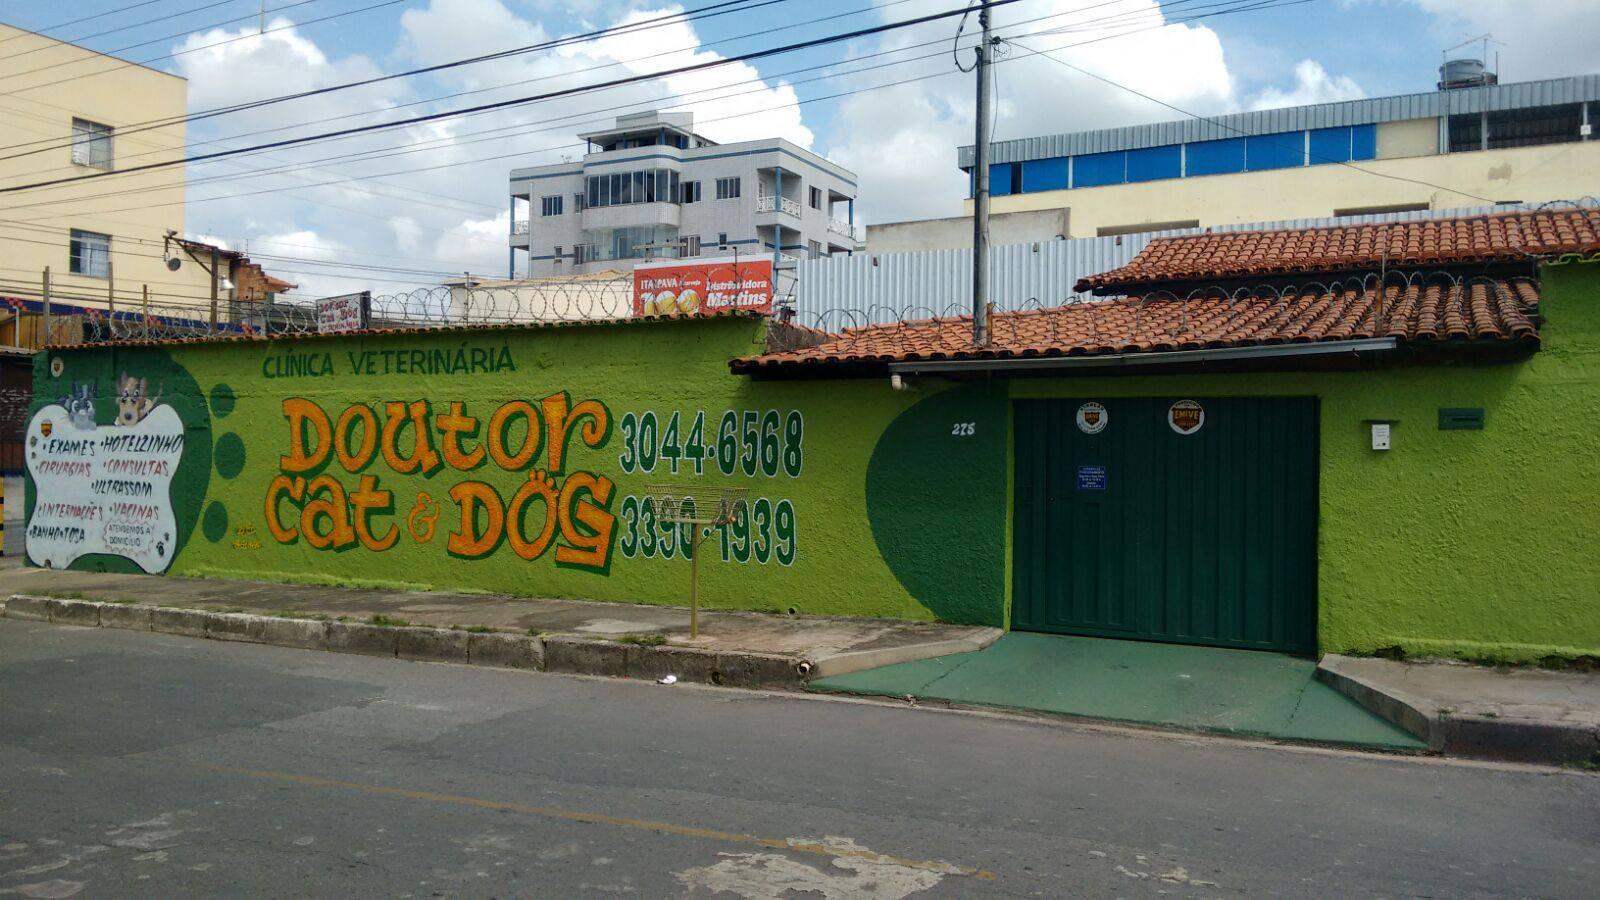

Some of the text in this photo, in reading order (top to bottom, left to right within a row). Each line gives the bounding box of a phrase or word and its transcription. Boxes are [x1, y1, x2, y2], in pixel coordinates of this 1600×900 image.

[263, 341, 516, 379] CLÍNICA VETERINÁRIA
[1174, 409, 1199, 419] EMIVE
[952, 422, 975, 436] 275
[49, 439, 95, 456] EXAMES
[103, 434, 184, 453] HOTELZINHO
[39, 461, 91, 477] CIRURGIAS
[107, 459, 168, 477] CONSULTAS
[94, 480, 152, 498] ULTRASSOM
[113, 502, 159, 521] VACINAS
[408, 491, 440, 544] &
[109, 523, 144, 535] ATENDEMOS
